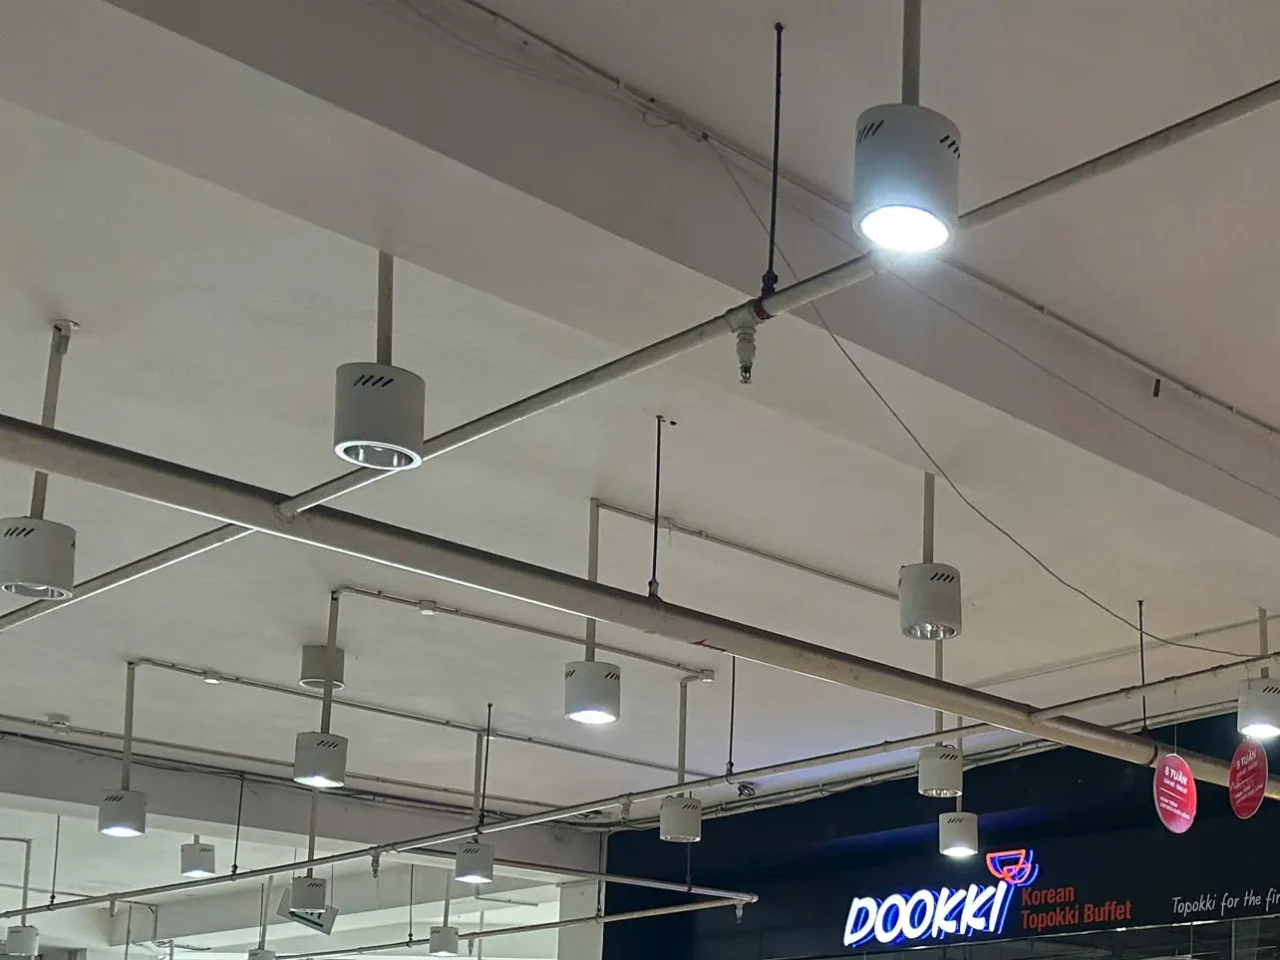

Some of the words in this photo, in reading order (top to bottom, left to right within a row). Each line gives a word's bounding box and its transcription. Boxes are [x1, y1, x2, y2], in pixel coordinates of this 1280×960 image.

[1022, 886, 1075, 906] Korean
[1172, 894, 1217, 917] Topokki
[1221, 892, 1239, 916] for
[1243, 889, 1261, 906] the
[843, 880, 1008, 947] DOOKKI
[1021, 905, 1079, 932] Topokki
[1083, 900, 1132, 923] Buffet
